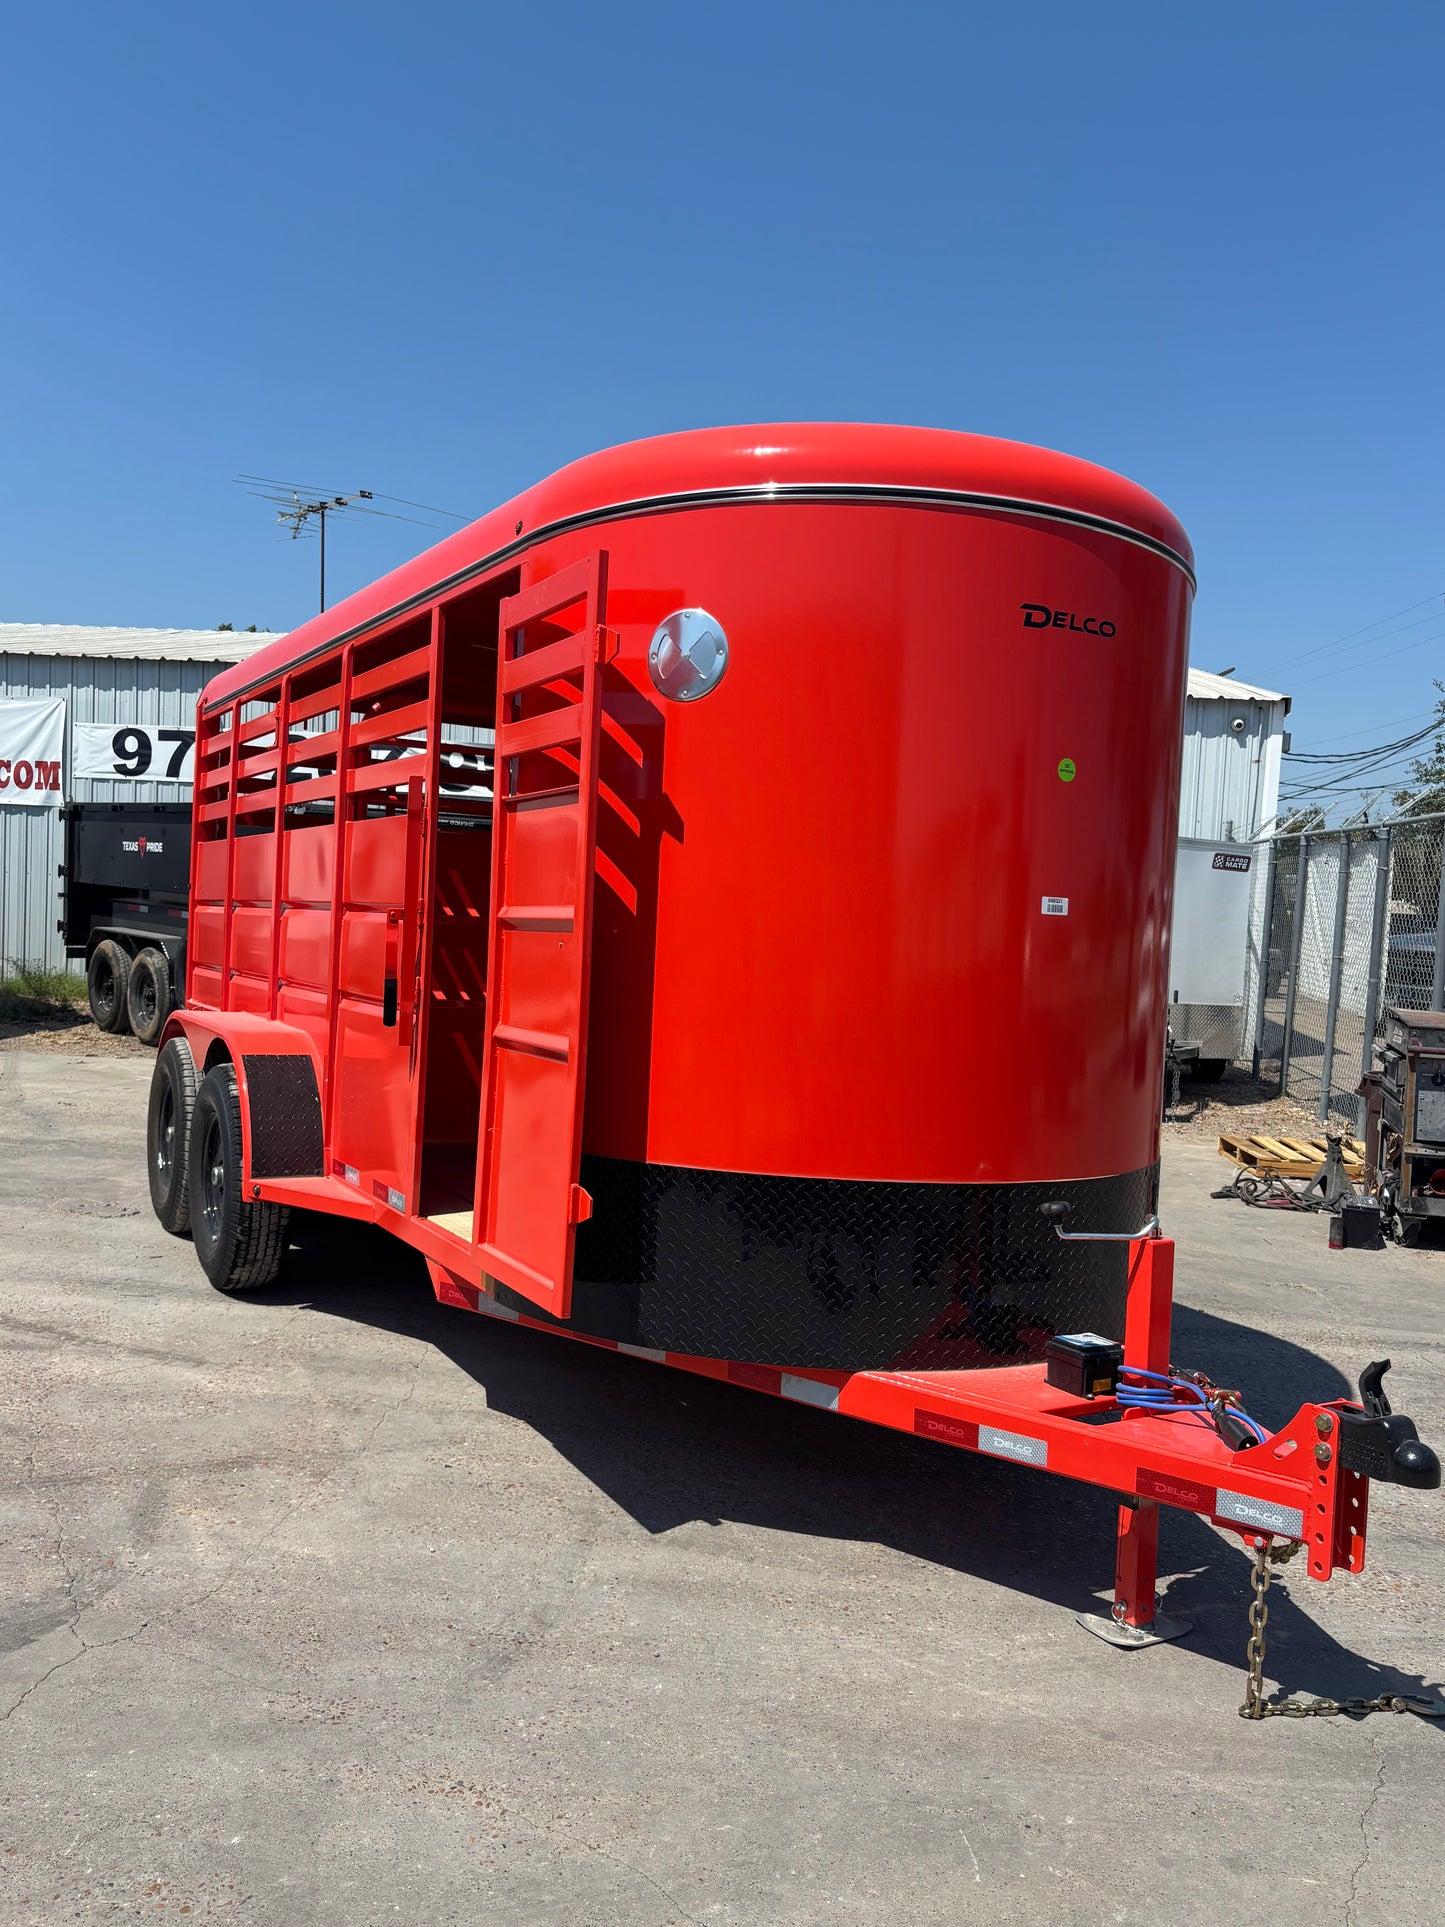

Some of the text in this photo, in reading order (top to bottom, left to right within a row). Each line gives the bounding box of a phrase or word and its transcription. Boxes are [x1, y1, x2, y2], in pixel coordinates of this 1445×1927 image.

[1020, 602, 1116, 638] DELCO
[122, 841, 163, 853] TEXAS PRIDE
[1225, 861, 1247, 869] MATE
[927, 1420, 964, 1436] DELCO
[993, 1436, 1032, 1453] DELCO
[1153, 1482, 1199, 1500] DELCO
[1234, 1503, 1283, 1523] DELCO
